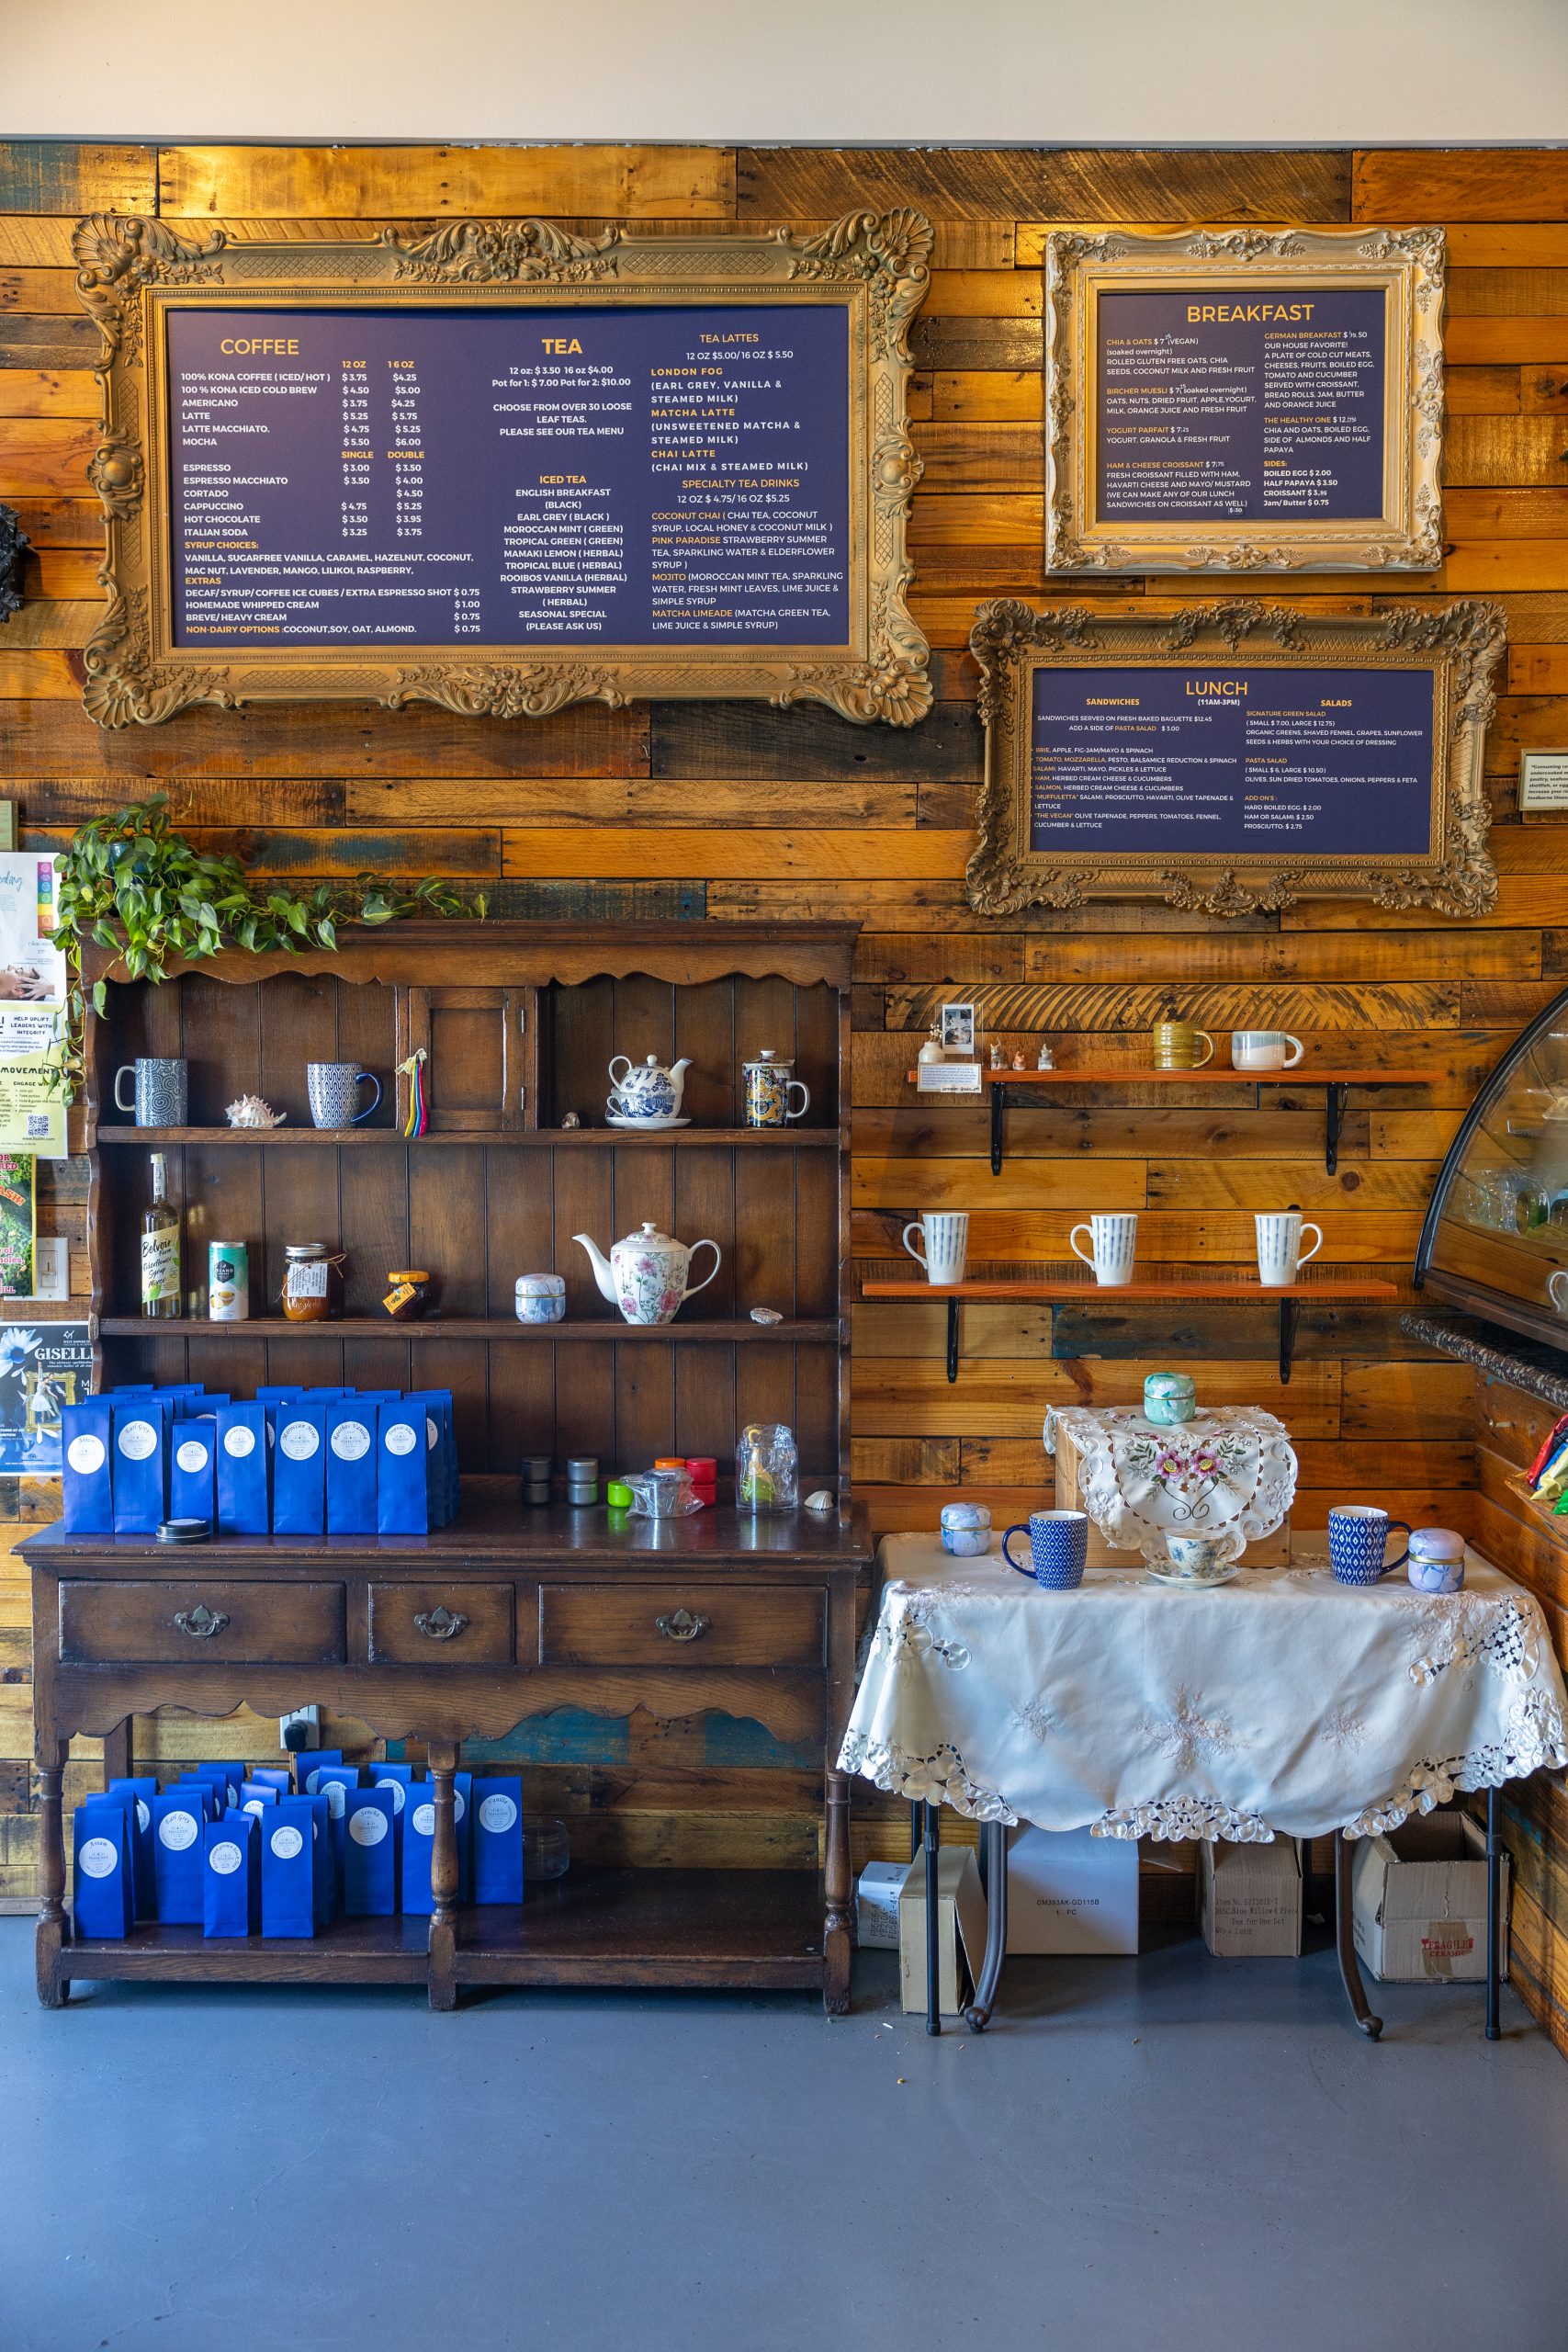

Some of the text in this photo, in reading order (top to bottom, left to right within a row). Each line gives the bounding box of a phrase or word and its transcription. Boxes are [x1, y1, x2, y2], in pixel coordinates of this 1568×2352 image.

[1187, 304, 1314, 322] BREAKFAST
[699, 334, 759, 343] TEA LATTES
[220, 339, 299, 354] COFFEE
[542, 339, 583, 354] TEA
[1135, 348, 1172, 356] overnight)
[651, 368, 697, 376] LONDON
[651, 382, 683, 391] (EARL
[391, 398, 415, 408] $4.25
[395, 437, 421, 447] $6.00
[540, 475, 587, 484] ICED TEA
[682, 479, 799, 488] SPECIALTY TEA DRINKS
[545, 501, 581, 509] (BLACK)
[585, 573, 627, 582] (HERBAL)
[1186, 681, 1248, 695] LUNCH
[142, 1238, 171, 1257] Belvoir
